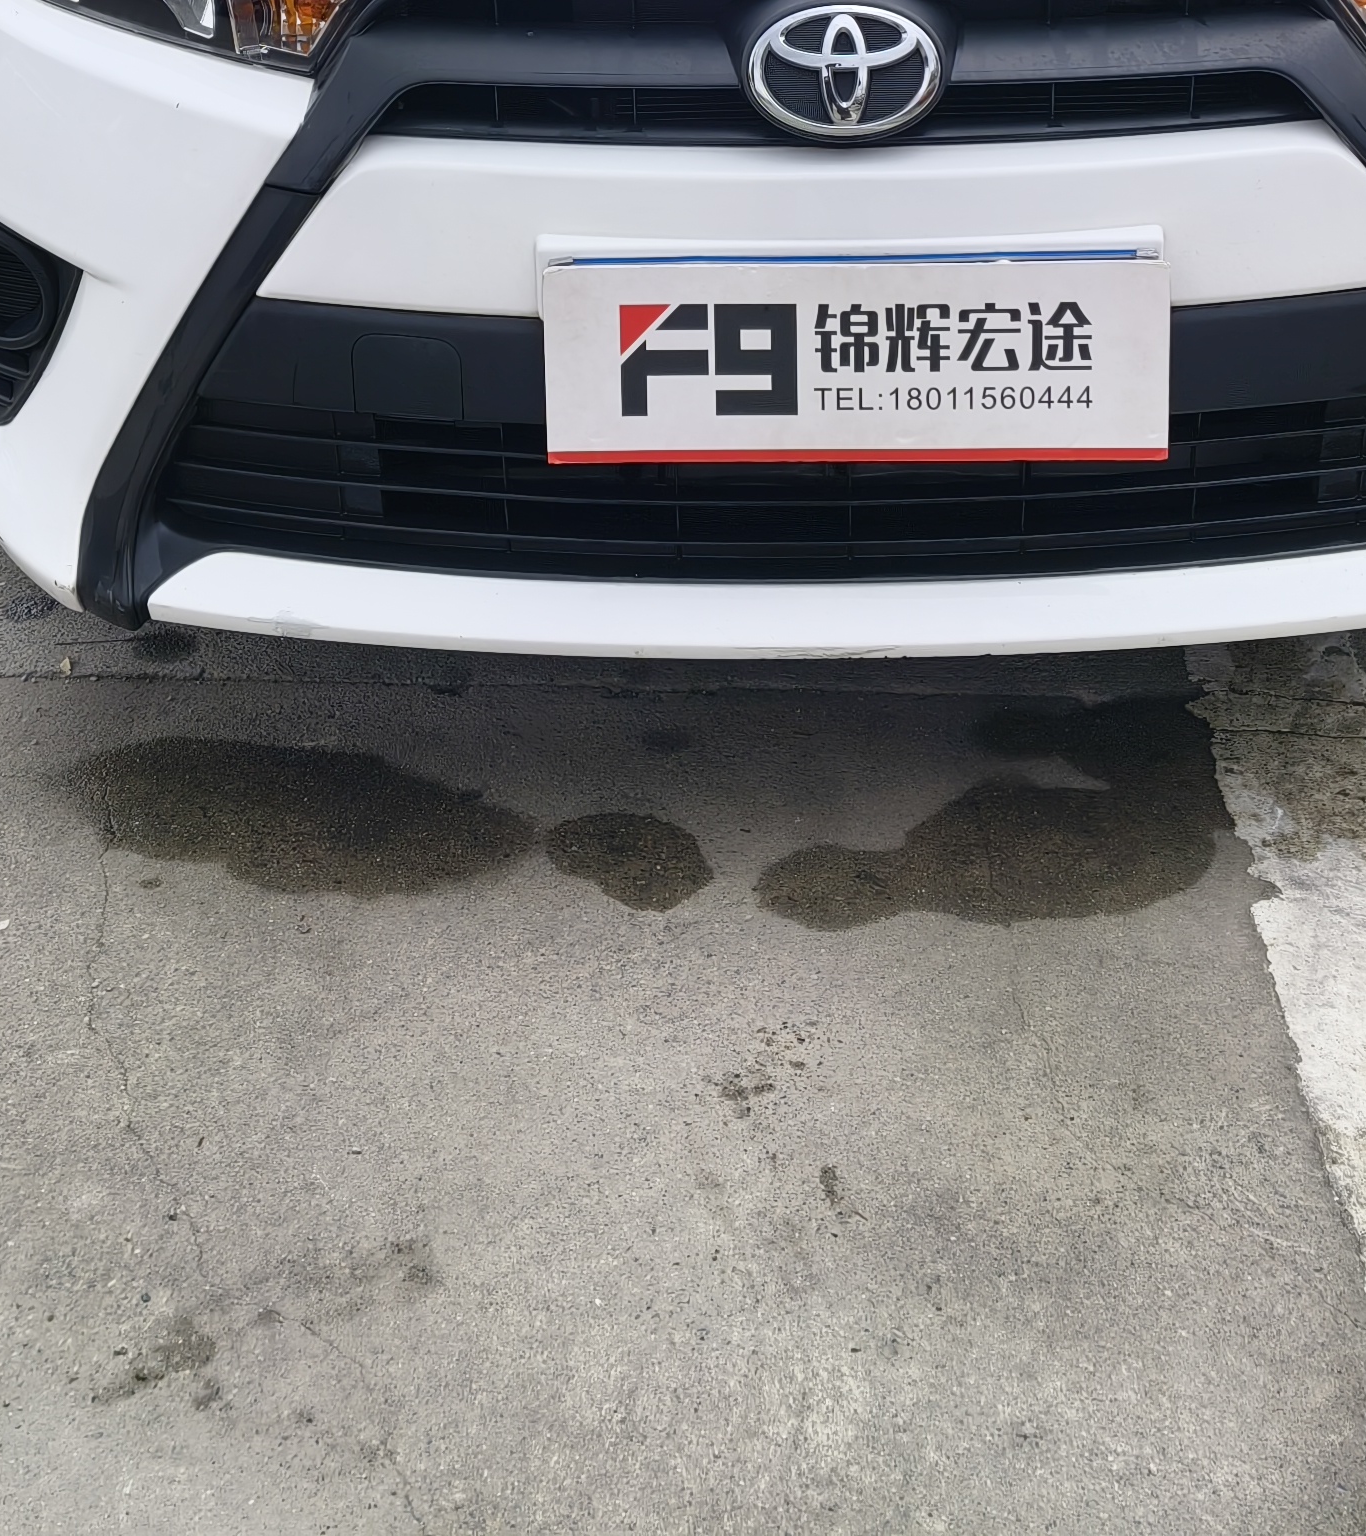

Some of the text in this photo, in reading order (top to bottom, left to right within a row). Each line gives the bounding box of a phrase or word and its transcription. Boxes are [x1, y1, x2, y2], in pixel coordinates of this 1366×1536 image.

[814, 301, 1093, 374] 锦辉宏途
[813, 385, 1094, 412] TEL:18011560444
